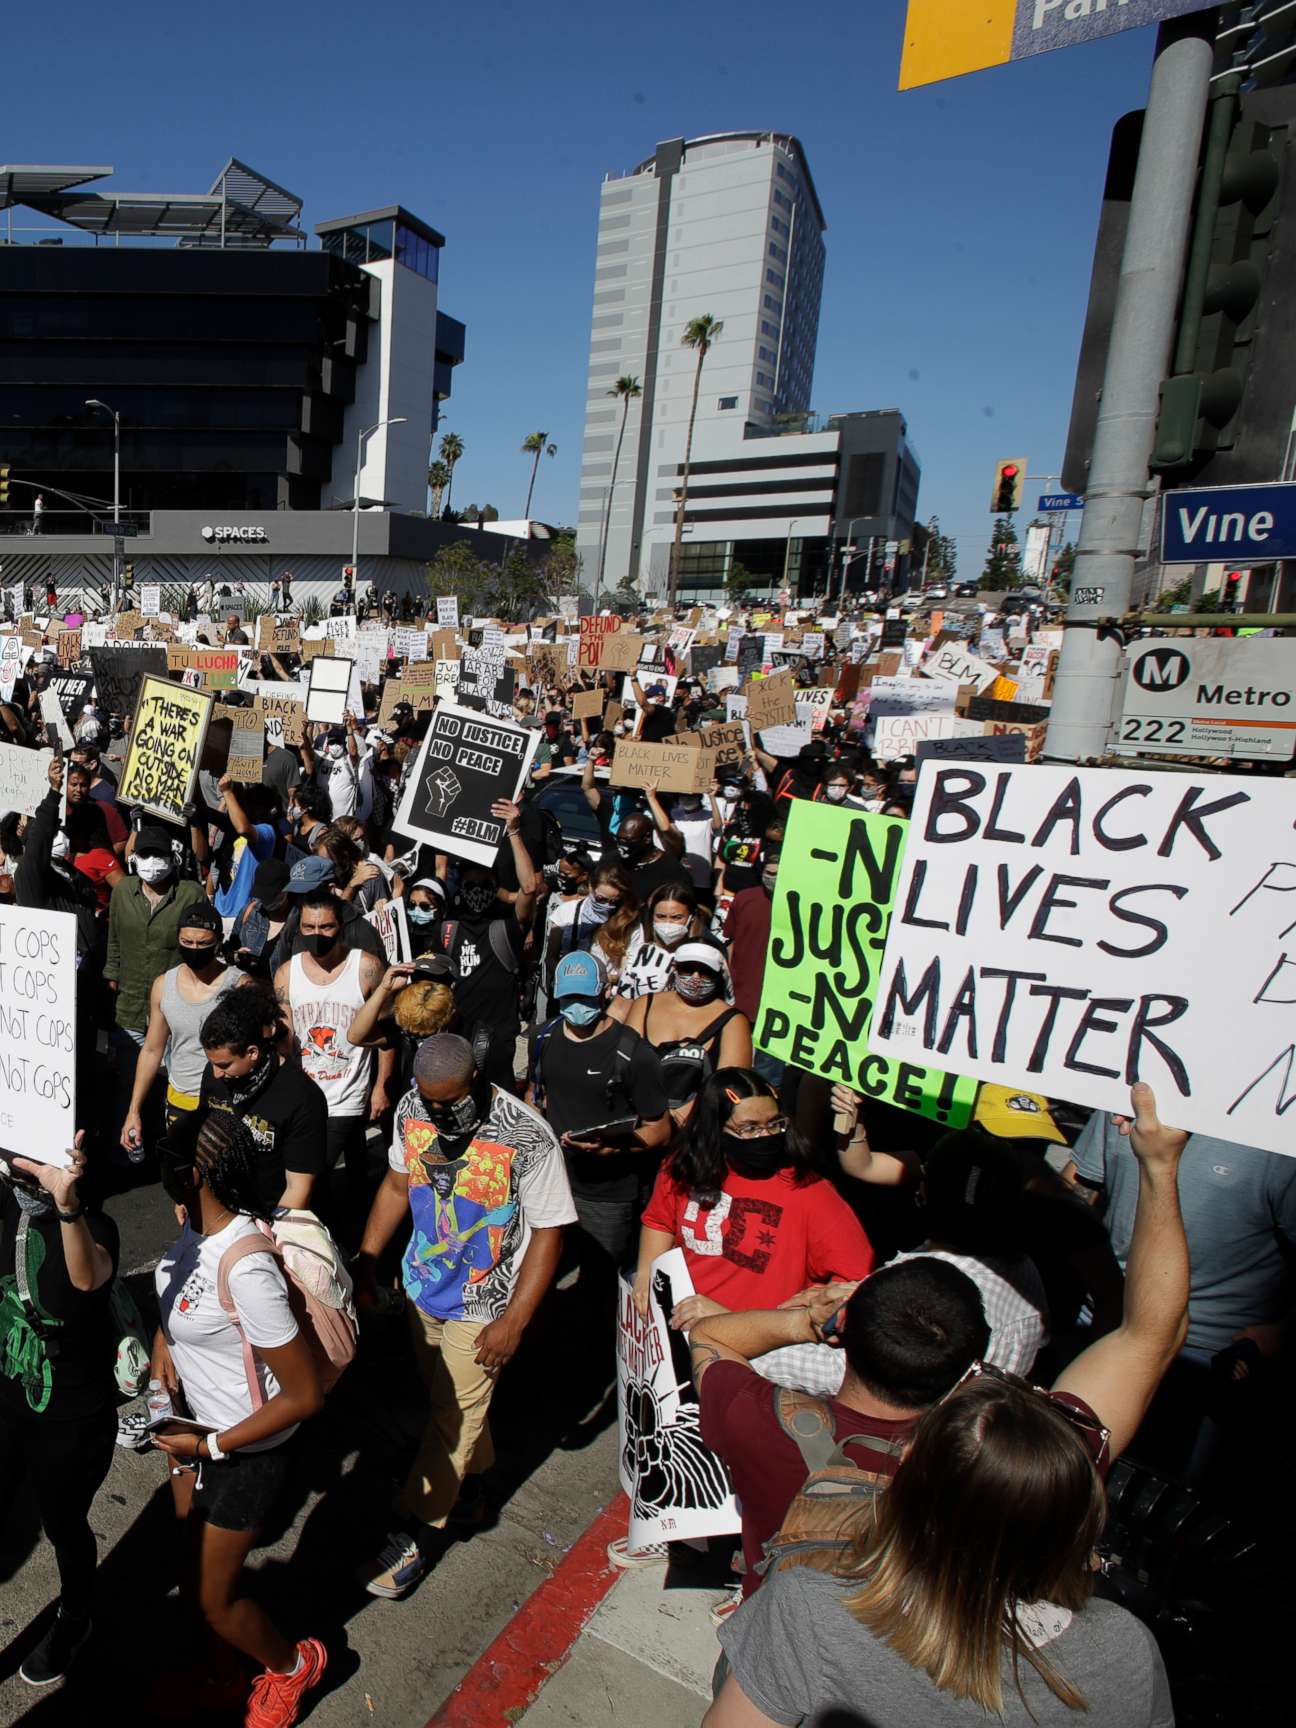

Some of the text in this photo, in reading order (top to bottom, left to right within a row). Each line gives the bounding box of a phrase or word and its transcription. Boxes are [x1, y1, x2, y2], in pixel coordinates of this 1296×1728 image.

[1043, 496, 1071, 507] Vine
[1178, 505, 1275, 544] Vine
[272, 628, 298, 640] DEFUND
[580, 616, 622, 634] DEFUND
[171, 655, 239, 670] TU LUCHA
[466, 660, 504, 677] ARABS
[937, 652, 983, 686] BLM
[1141, 655, 1184, 685] M
[64, 679, 87, 696] HER
[458, 682, 493, 699] BLACK
[476, 676, 497, 687] FOR
[794, 690, 829, 705] LIVES
[1195, 684, 1292, 707] Metro
[144, 716, 187, 742] A WAR
[436, 716, 461, 736] NO
[881, 716, 954, 738] I CAN'T
[1121, 718, 1186, 744] 222
[1191, 727, 1233, 735] Hollywood
[135, 729, 198, 769] GOING ON
[430, 739, 503, 777] NO PEACE
[618, 745, 689, 765] BLACK LIVES
[137, 752, 187, 784] OUTSIDE
[627, 762, 673, 778] MATTER
[126, 780, 142, 799] IS
[132, 767, 187, 805] NO MAN
[923, 769, 1251, 861] BLACK
[451, 816, 501, 844] #BLM
[900, 859, 1190, 958] LIVES
[14, 927, 61, 965] COPS
[460, 944, 477, 956] WE
[771, 890, 892, 998] JUS
[459, 954, 481, 968] RUN
[13, 965, 58, 1004] COPS
[0, 1004, 30, 1041] NOT
[35, 1014, 74, 1053] COPS
[877, 955, 1191, 1098] MATTER
[760, 1008, 961, 1123] PEACE!
[33, 1064, 72, 1110] COPS
